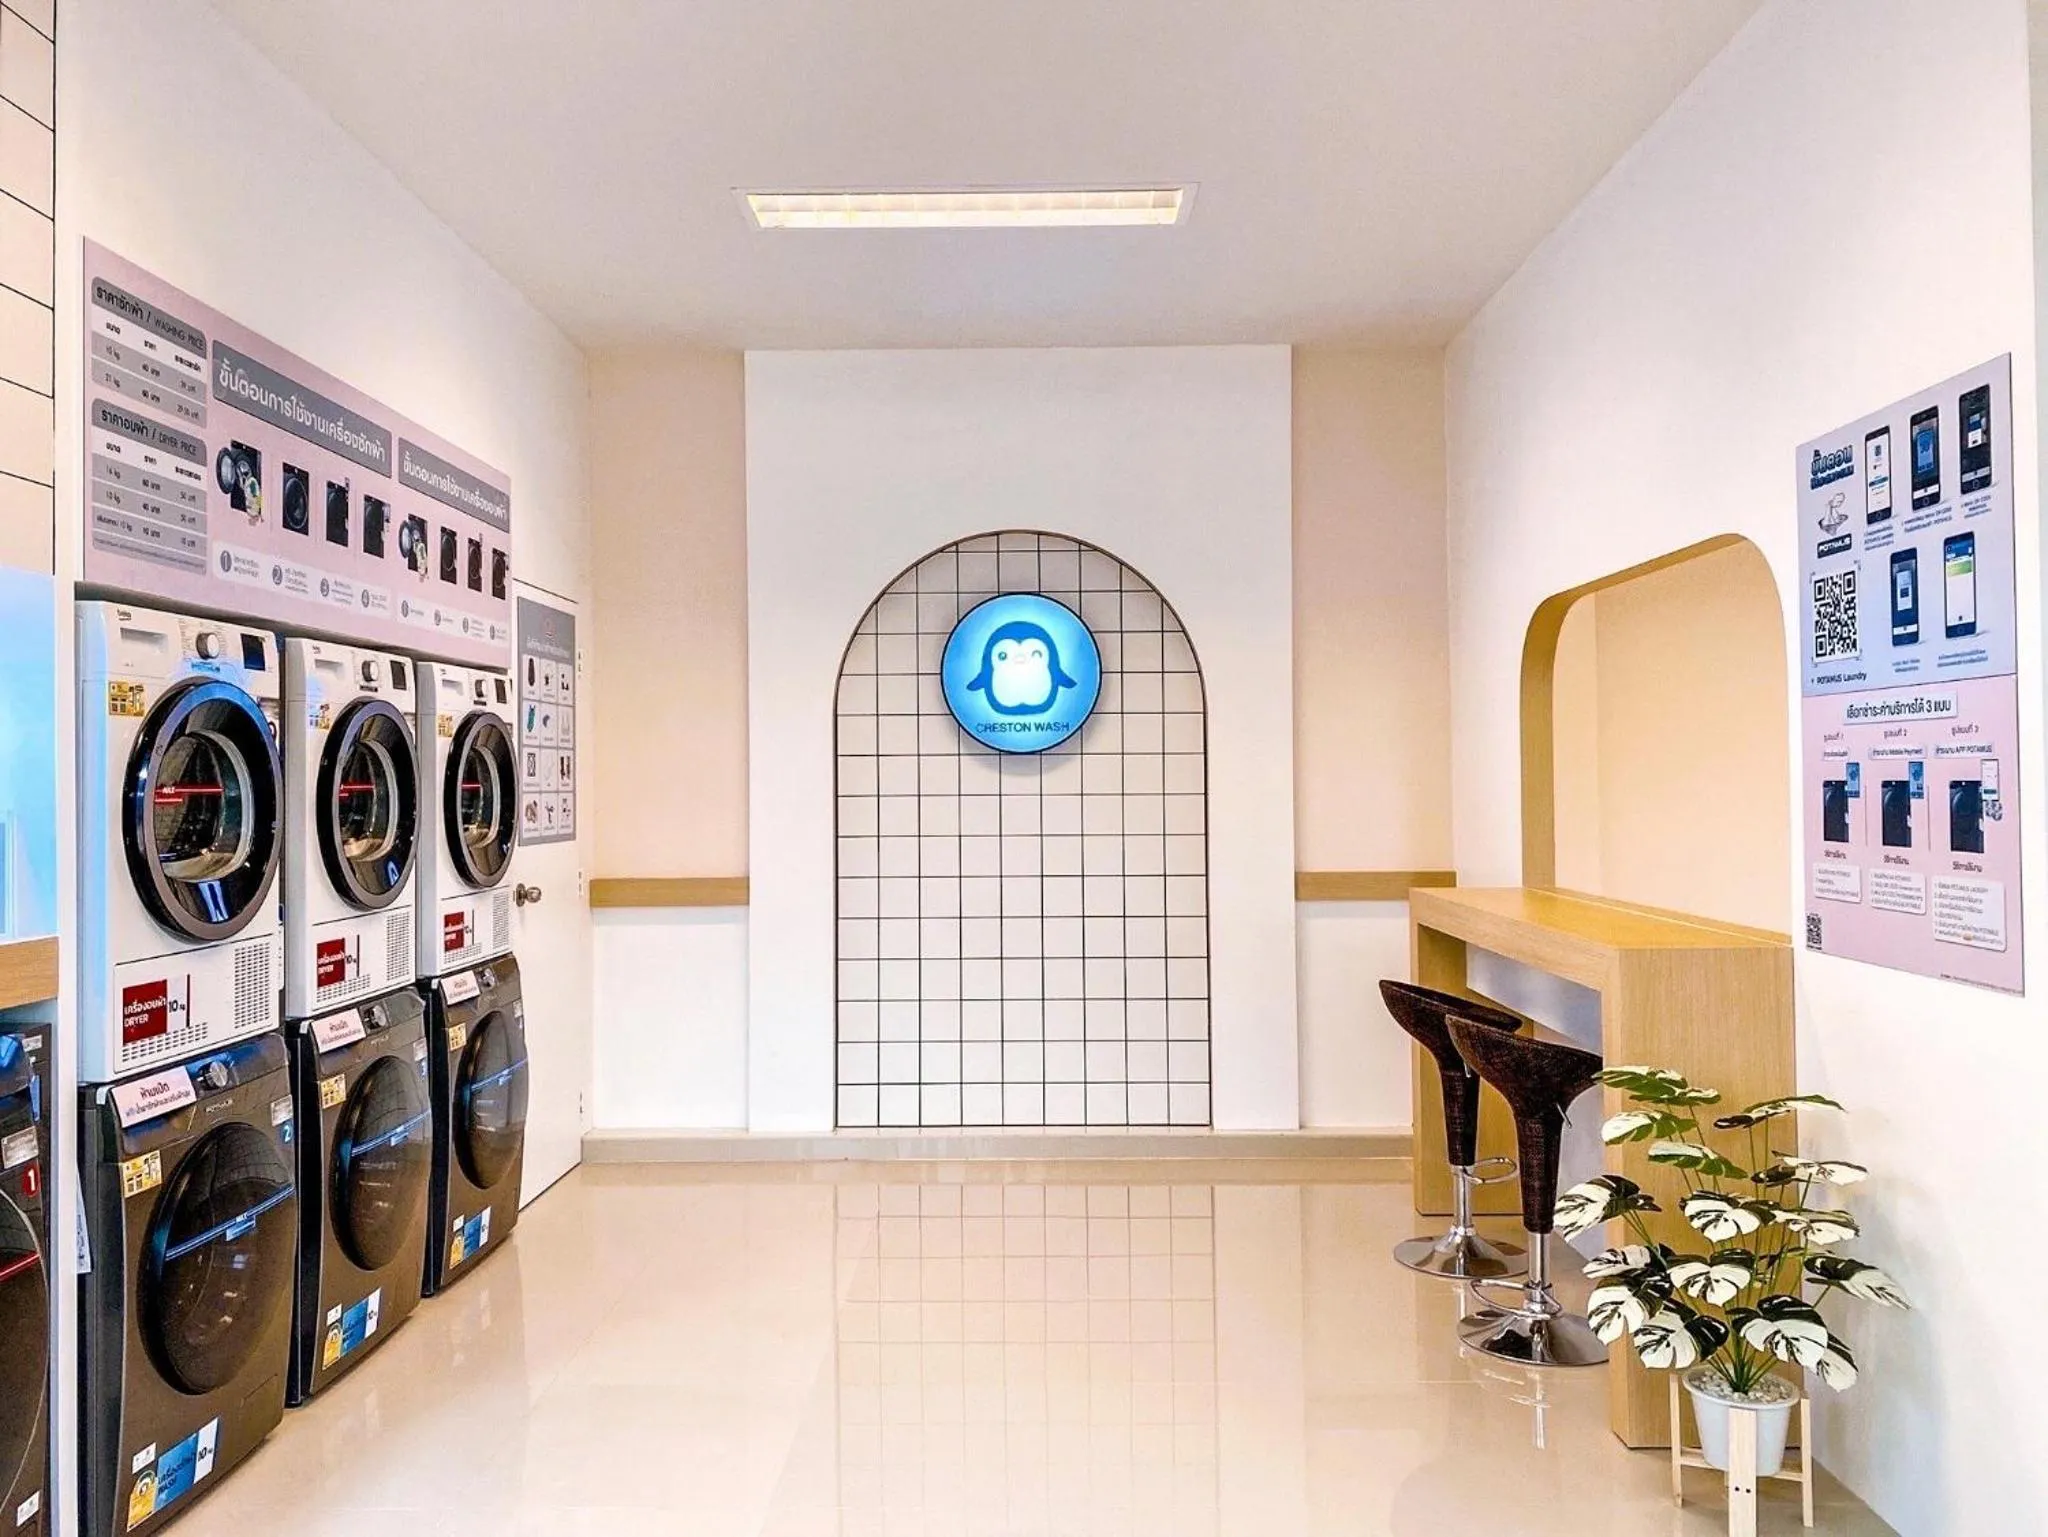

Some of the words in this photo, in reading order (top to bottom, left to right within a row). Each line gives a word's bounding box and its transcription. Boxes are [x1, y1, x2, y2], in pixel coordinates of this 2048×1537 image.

[219, 357, 386, 463] ขั้นตอนการใช้งานเครื่องซักผ้า
[1843, 672, 1867, 683] Laundry
[976, 721, 1032, 734] CRESTON
[1034, 721, 1070, 733] WASH
[168, 999, 178, 1013] 10
[123, 1014, 149, 1028] DRYER
[283, 1124, 291, 1142] 2
[28, 1168, 35, 1192] 1
